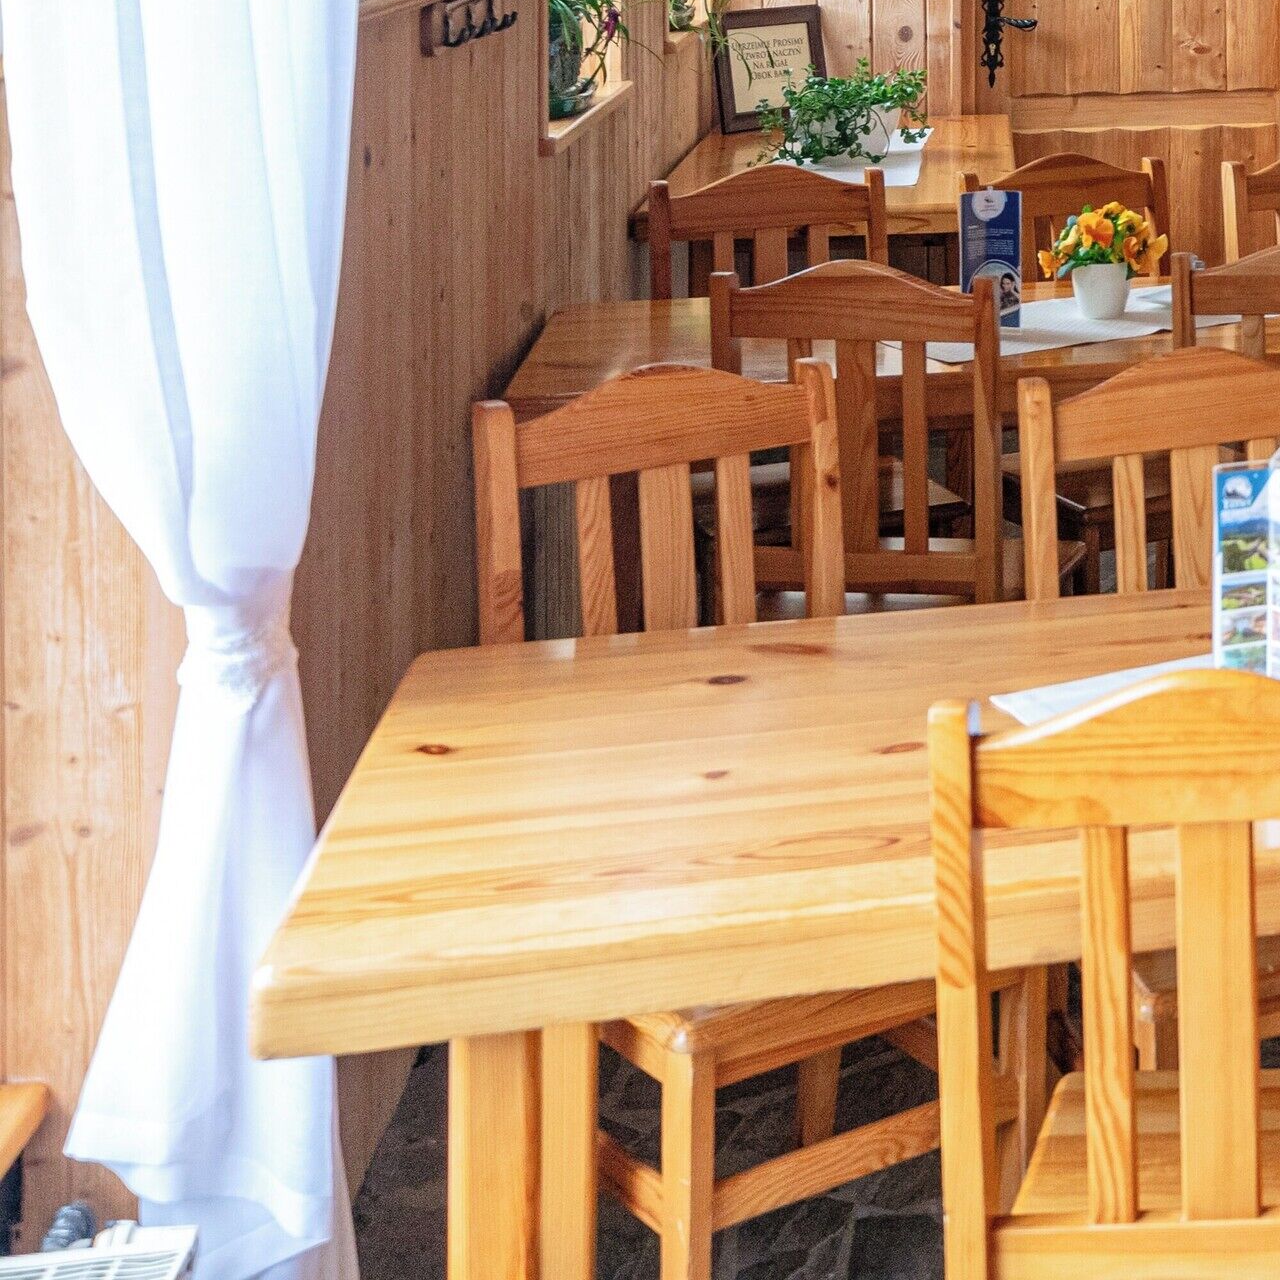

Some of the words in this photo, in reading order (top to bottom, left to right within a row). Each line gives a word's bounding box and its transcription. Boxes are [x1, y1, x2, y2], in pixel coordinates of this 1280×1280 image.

[773, 38, 804, 48] PROSIMY
[745, 51, 769, 61] ZWRO
[773, 47, 802, 57] NACZYŃ
[766, 59, 788, 69] RGAŁ
[774, 69, 787, 78] BA
